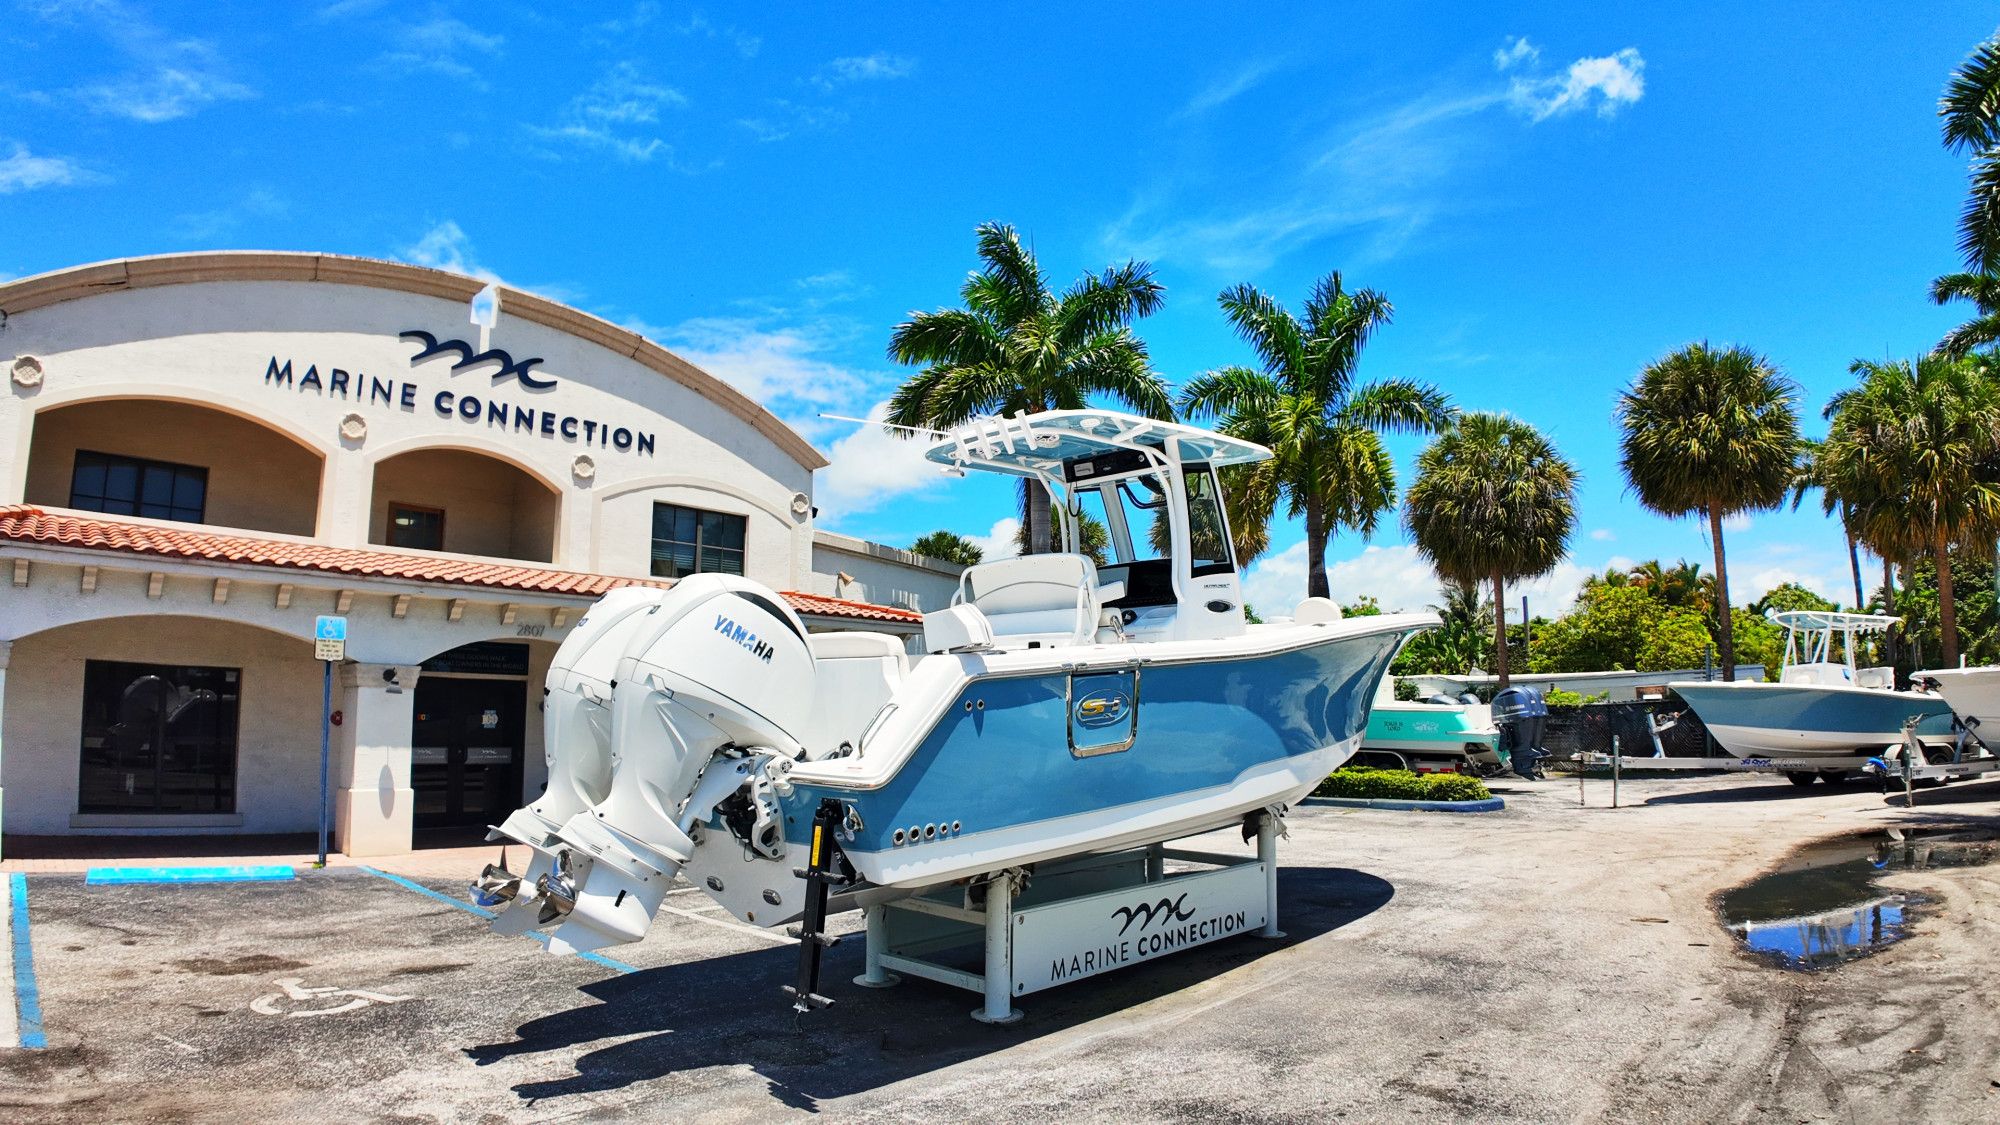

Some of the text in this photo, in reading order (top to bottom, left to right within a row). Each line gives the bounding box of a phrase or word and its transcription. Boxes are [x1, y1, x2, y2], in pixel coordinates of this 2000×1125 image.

[265, 355, 656, 456] MARINE CONNECTION
[516, 624, 546, 637] 2807
[713, 614, 774, 664] YAMAHA
[1050, 910, 1246, 982] MARINE CONNECTION
